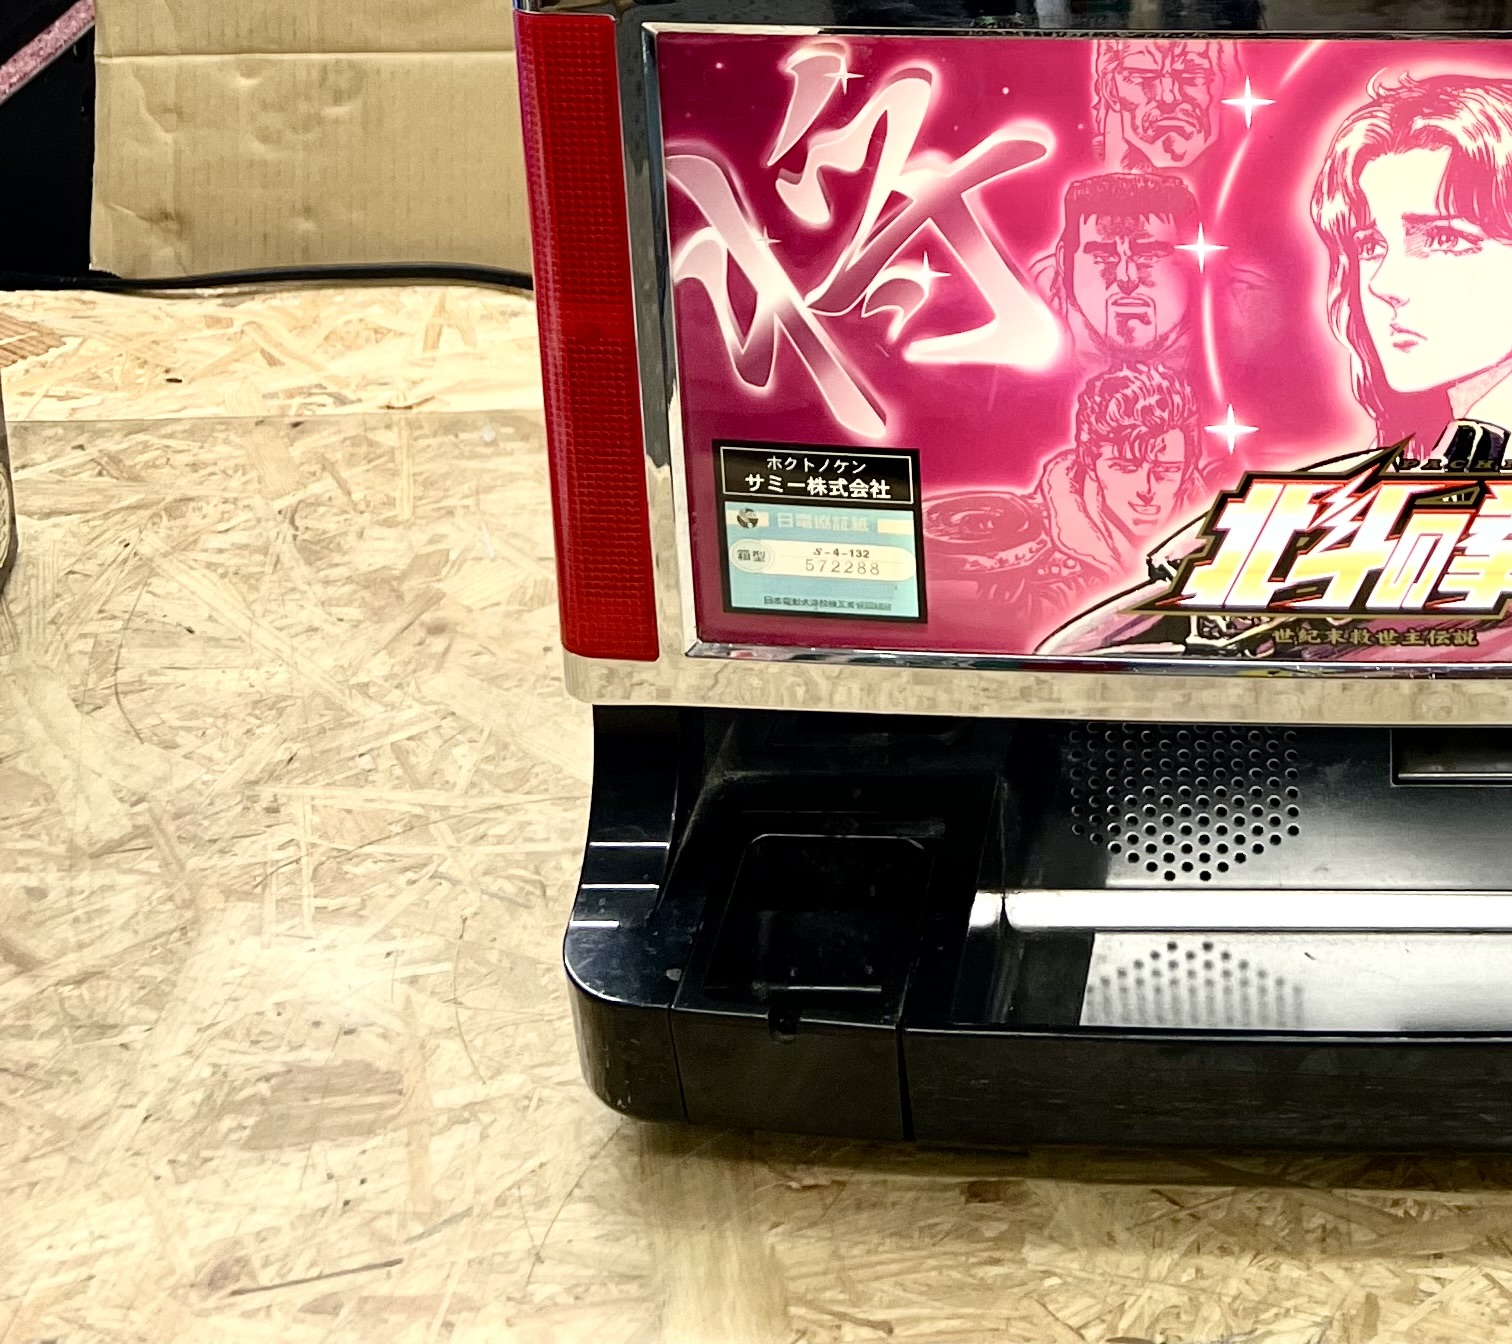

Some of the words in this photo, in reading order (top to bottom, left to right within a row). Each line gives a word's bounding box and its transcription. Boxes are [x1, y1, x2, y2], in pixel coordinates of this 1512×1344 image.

[766, 455, 867, 474] ホクトノケン
[745, 474, 892, 499] サミー株式会社
[805, 558, 881, 576] 572288
[1273, 628, 1480, 647] 世紀末救世主伝説
